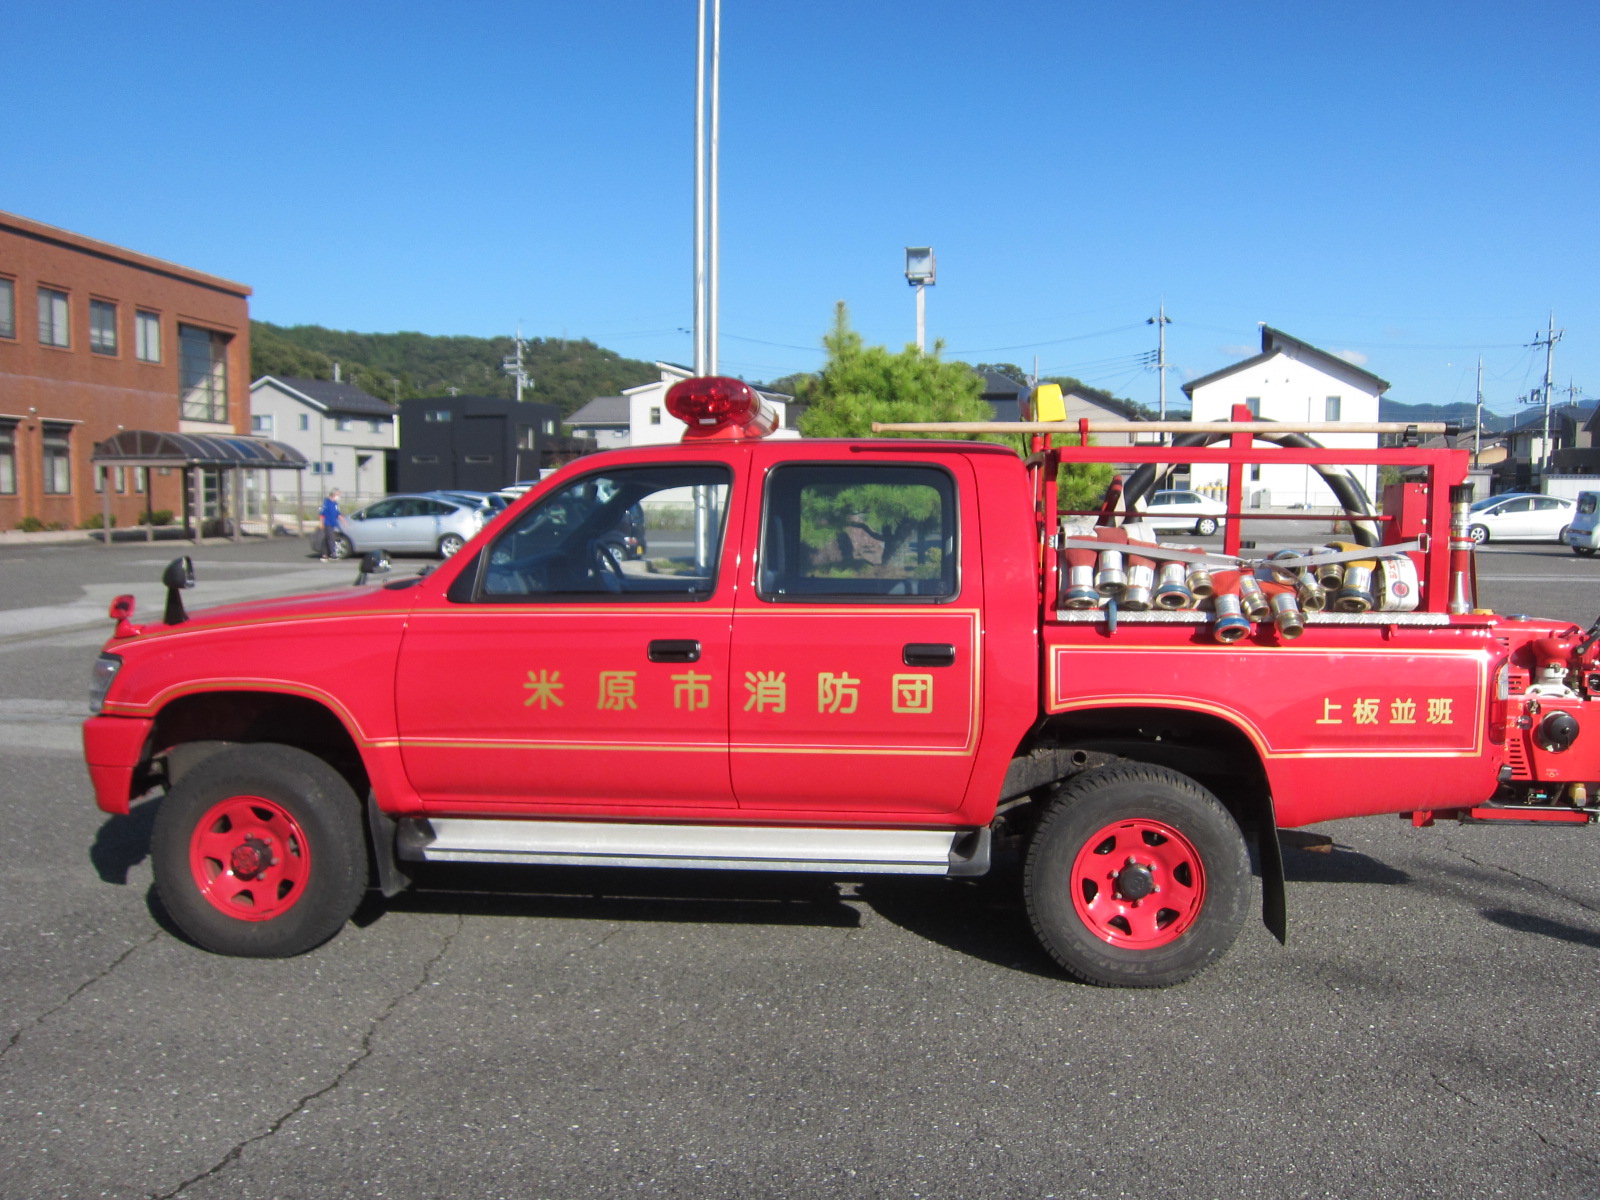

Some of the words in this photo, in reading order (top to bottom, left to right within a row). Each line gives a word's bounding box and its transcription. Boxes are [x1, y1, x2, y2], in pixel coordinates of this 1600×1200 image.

[523, 669, 934, 714] 米原市消防団
[1315, 697, 1454, 724] 上板並班
